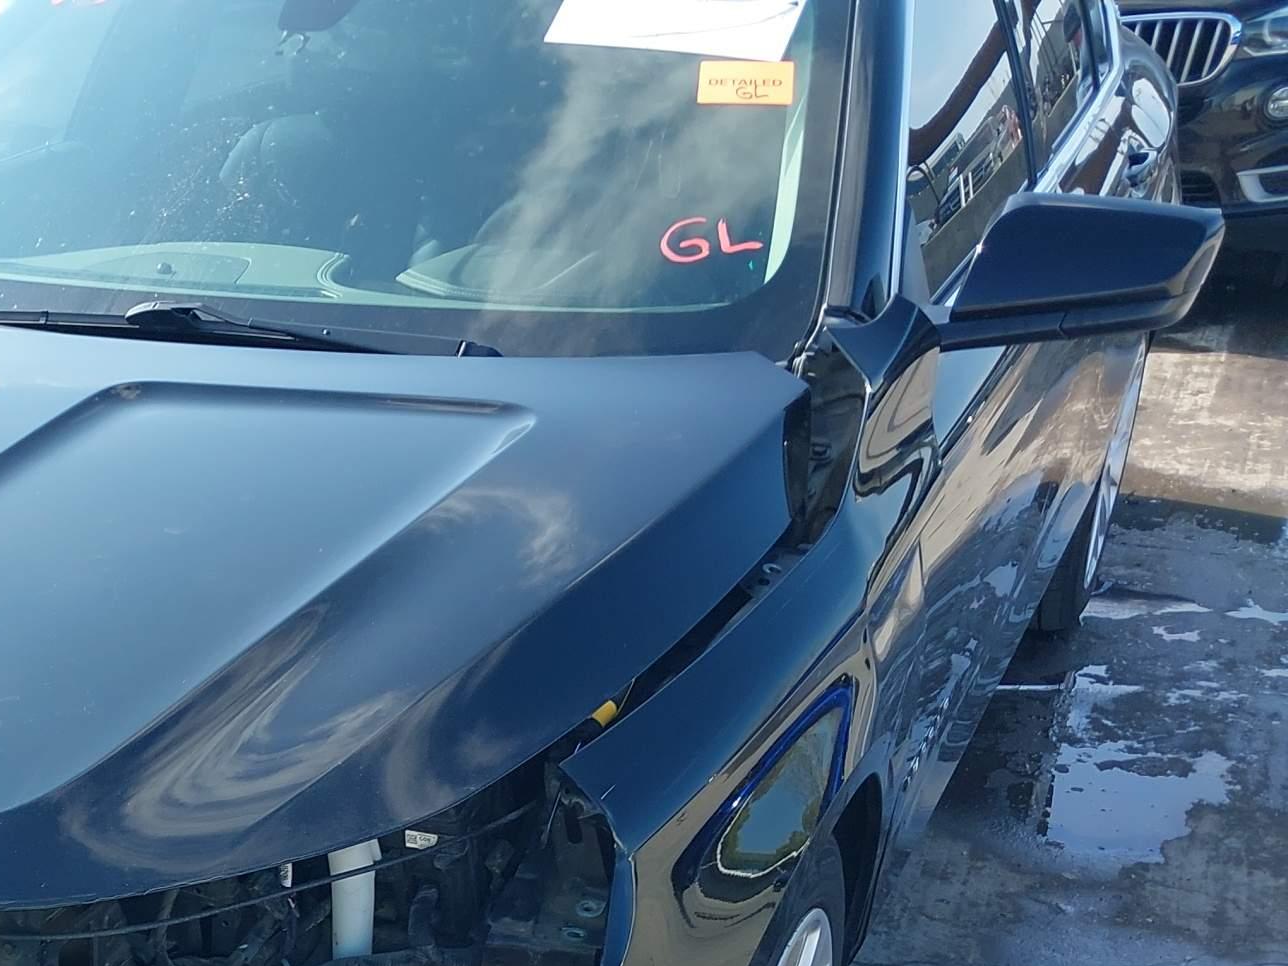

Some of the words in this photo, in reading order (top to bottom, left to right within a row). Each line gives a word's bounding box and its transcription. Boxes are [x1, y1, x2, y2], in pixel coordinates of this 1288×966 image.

[708, 78, 783, 87] DETAILED
[735, 82, 769, 100] GL
[660, 218, 762, 263] GL
